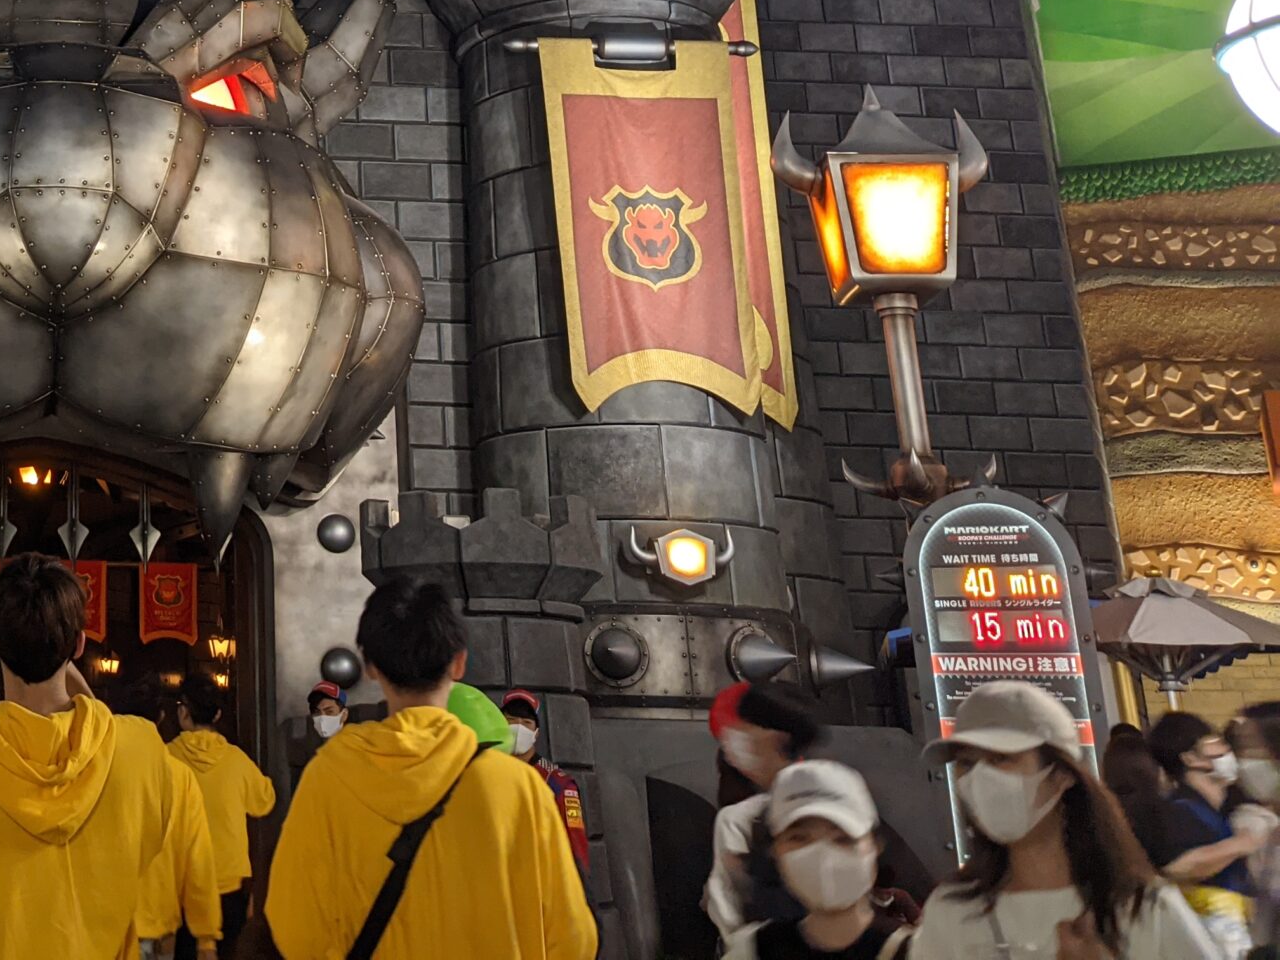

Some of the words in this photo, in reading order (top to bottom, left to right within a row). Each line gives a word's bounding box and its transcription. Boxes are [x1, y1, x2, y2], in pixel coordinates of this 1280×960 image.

[942, 554, 969, 564] WAIT
[971, 553, 996, 563] TIME
[1001, 553, 1039, 563] 待ち時間
[964, 567, 996, 597] 40
[1009, 568, 1058, 595] min
[934, 600, 967, 608] SINGLE
[1005, 599, 1061, 607] シングルライダー
[972, 612, 1001, 640] 15
[1016, 613, 1064, 638] min
[938, 657, 1034, 672] WARNING!
